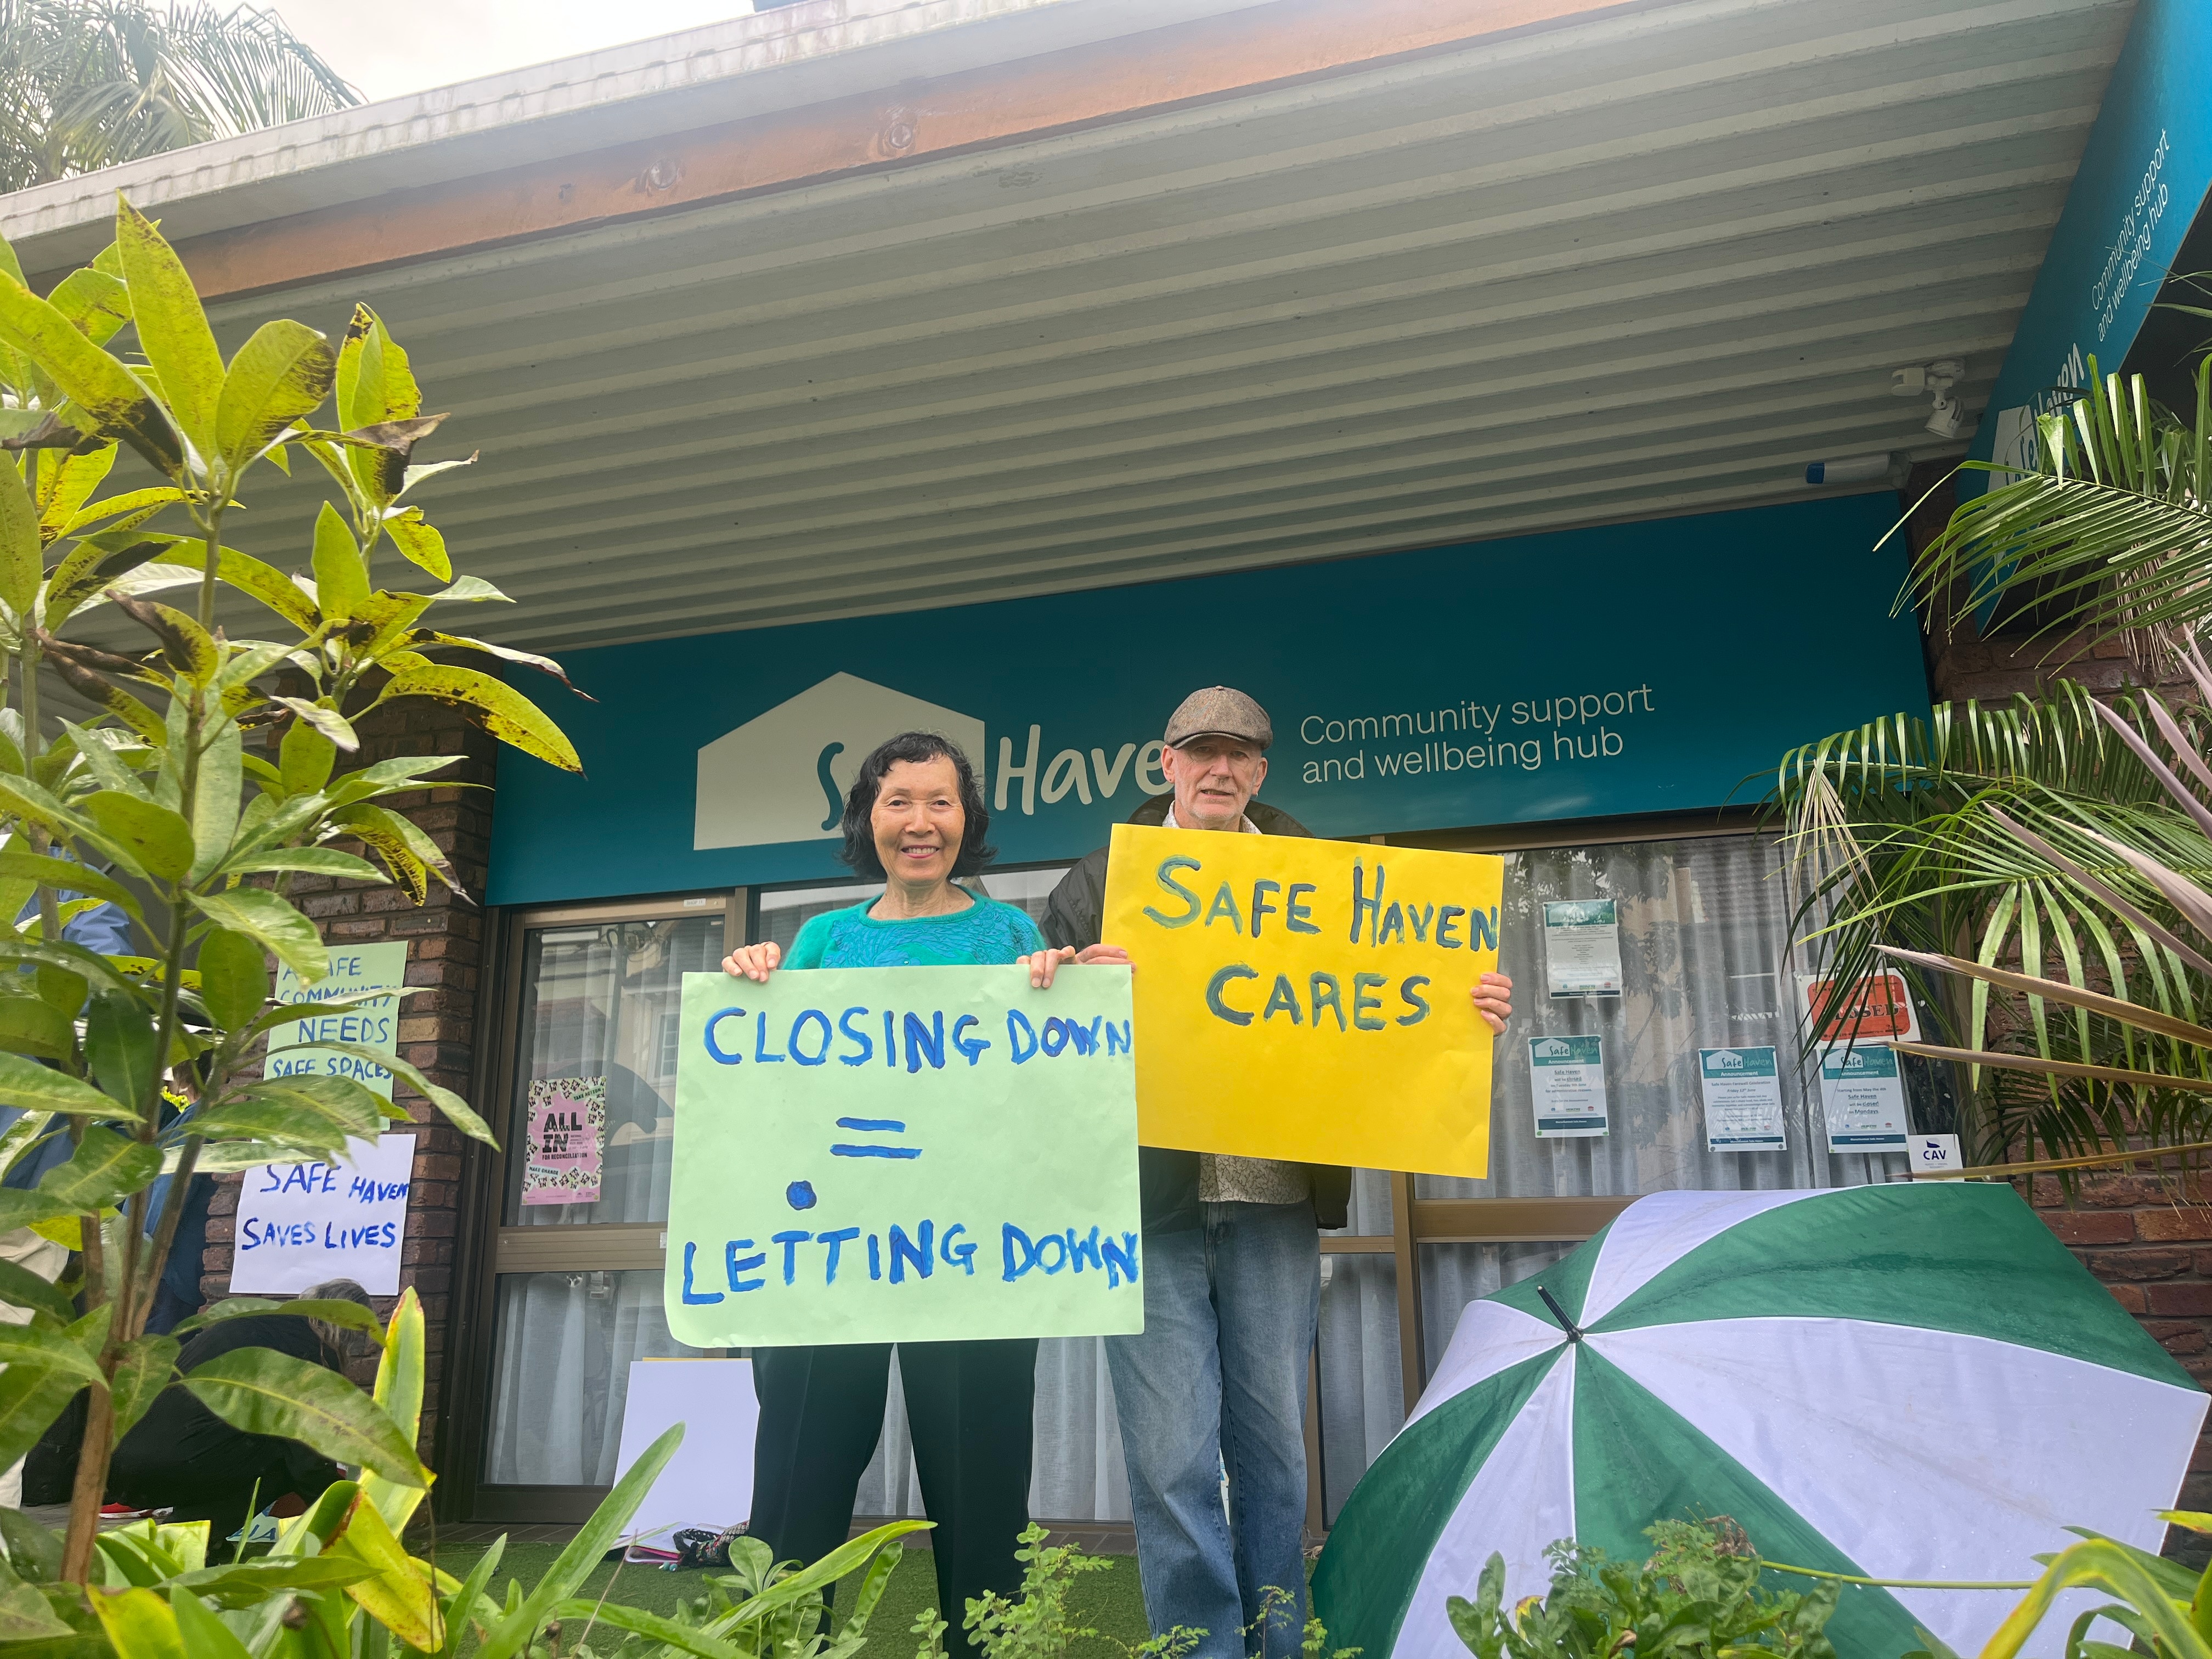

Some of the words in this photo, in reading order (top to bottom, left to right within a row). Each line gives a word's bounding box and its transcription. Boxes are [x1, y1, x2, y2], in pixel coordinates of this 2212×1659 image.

[2092, 213, 2135, 311] Community
[2134, 128, 2170, 216] support
[2098, 304, 2113, 342] and
[2111, 227, 2151, 306] wellbeing
[2149, 182, 2169, 231] hub
[1300, 700, 1501, 745] Community
[1511, 683, 1655, 729] support
[994, 724, 1173, 816] Have
[1303, 750, 1365, 784] and
[1374, 737, 1541, 777] wellbeing
[1553, 726, 1623, 761] hub
[1142, 854, 1321, 939] SAFE
[1350, 857, 1498, 952] HAVEN
[1205, 961, 1431, 1032] CARES
[298, 1017, 390, 1043] NEEDS
[704, 1006, 991, 1073] CLOSING
[1007, 1008, 1131, 1065] DOWN
[1550, 1046, 1569, 1056] Safe
[1570, 1044, 1598, 1055] Haven
[1722, 1058, 1742, 1068] Safe
[1743, 1056, 1772, 1066] Haven
[542, 1133, 568, 1153] IN
[543, 1112, 582, 1132] ALL
[259, 1162, 342, 1194] SAFE
[348, 1176, 410, 1204] HAVEN
[1923, 1150, 1946, 1160] CAV
[241, 1217, 316, 1250] SAVES
[325, 1221, 396, 1249] LIVES
[682, 1220, 978, 1305] LETTING
[1002, 1223, 1138, 1290] DOWN
